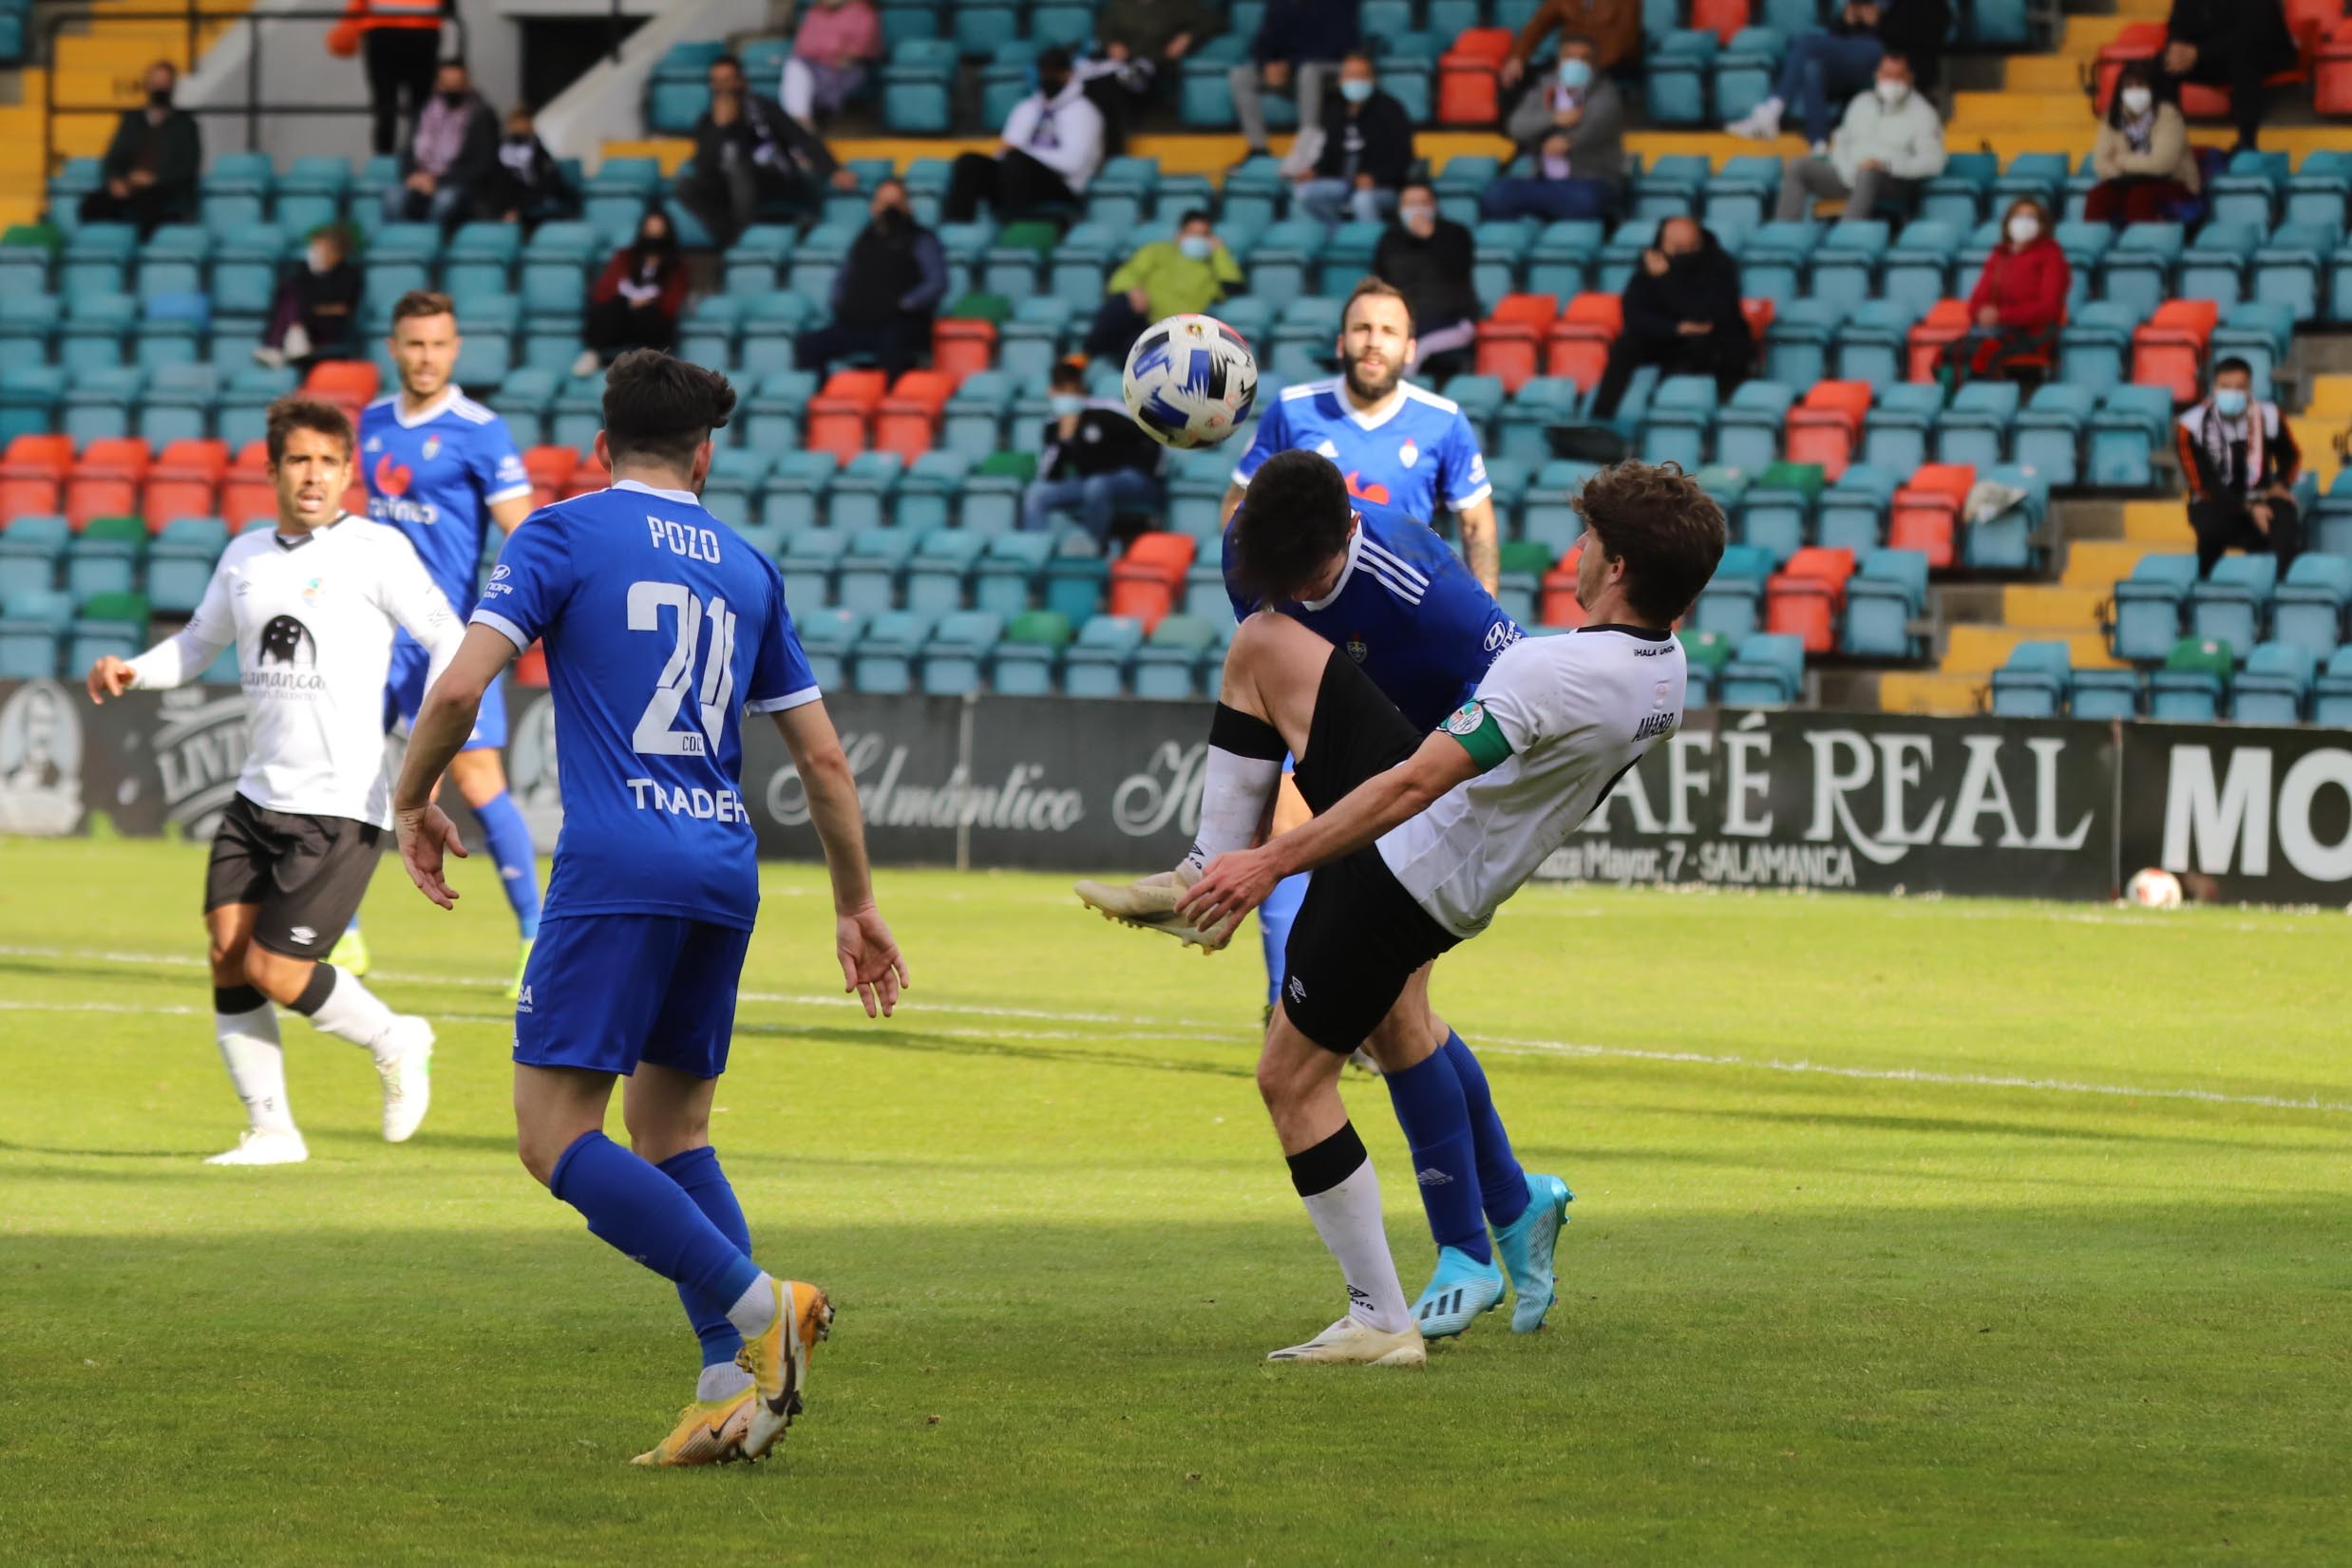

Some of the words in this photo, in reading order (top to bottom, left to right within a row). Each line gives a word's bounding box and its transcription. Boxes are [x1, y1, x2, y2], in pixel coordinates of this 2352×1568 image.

[646, 515, 721, 564] POZO
[627, 580, 737, 758] 21
[1580, 711, 1773, 837] AFÉ
[1801, 728, 2095, 864] REAL
[2159, 744, 2352, 882] MO
[1698, 840, 1856, 887] SALAMANCA
